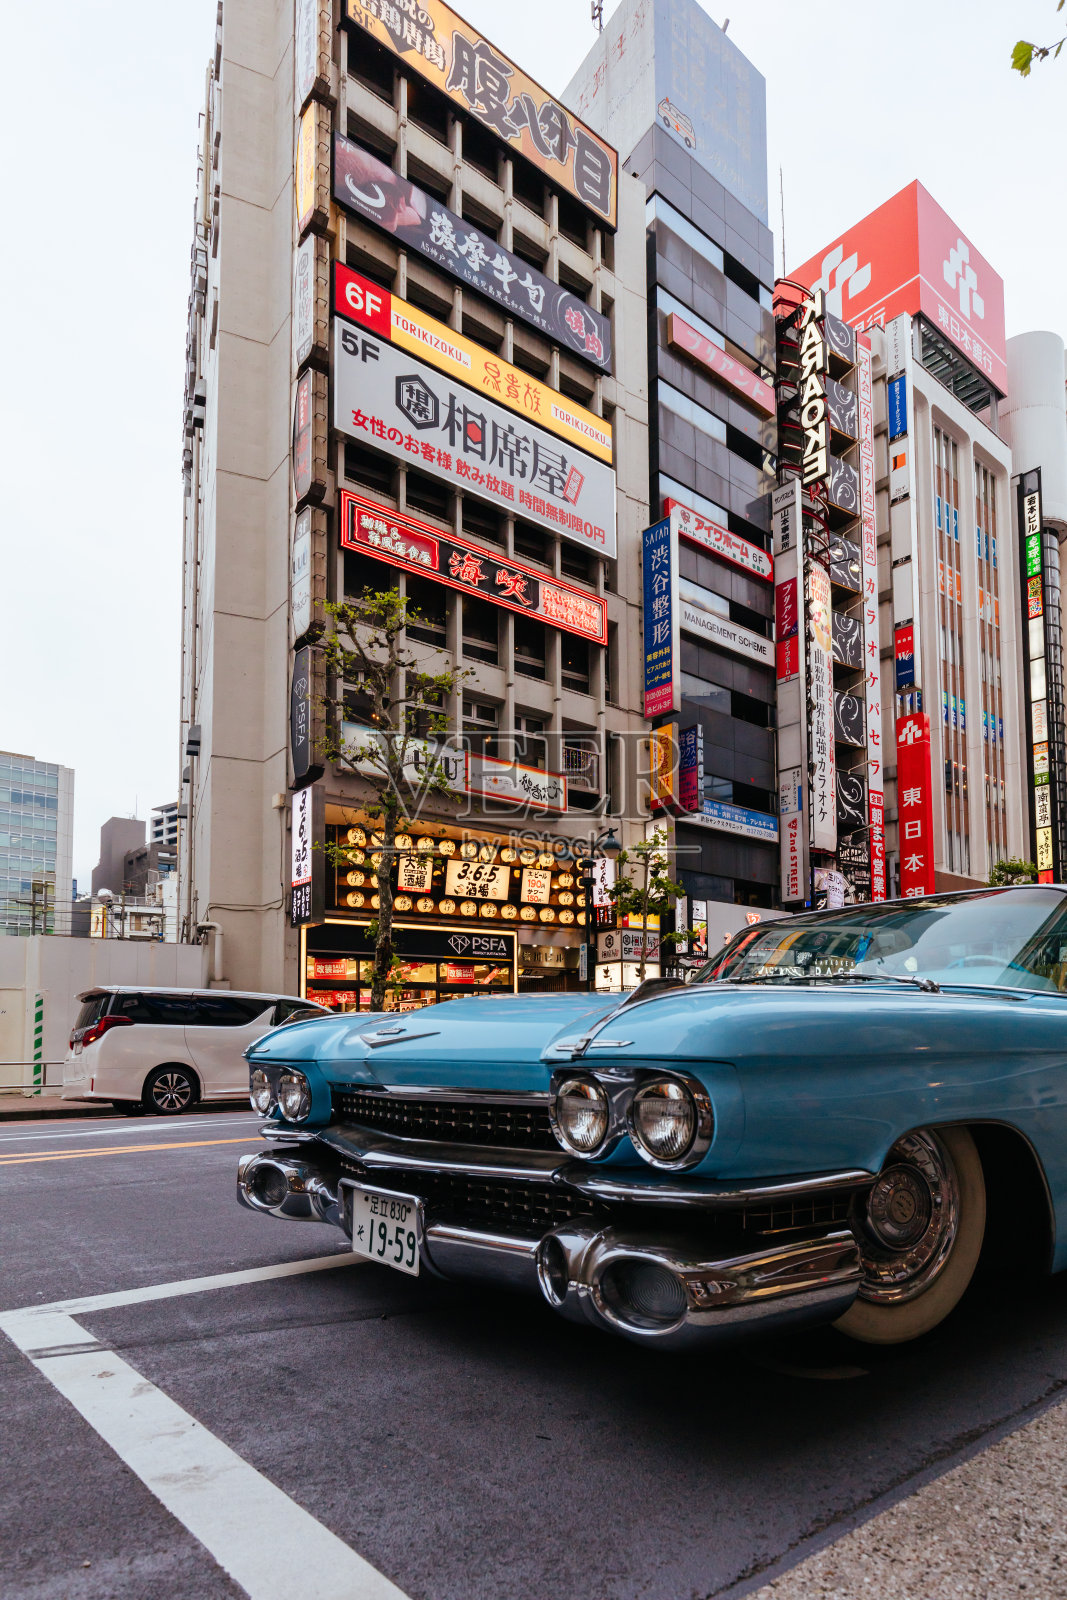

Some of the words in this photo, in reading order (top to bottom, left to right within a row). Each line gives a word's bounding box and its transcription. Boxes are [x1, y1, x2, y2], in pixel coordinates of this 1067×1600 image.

[353, 4, 376, 29] 8F
[447, 30, 611, 217] 腹八分目
[345, 282, 382, 317] 6F
[341, 327, 380, 364] 5F
[394, 313, 462, 362] TORIKIZOKU
[565, 306, 603, 360] 焼肉
[937, 304, 993, 374] 東日本銀行
[860, 352, 871, 398] ママ会
[441, 391, 570, 503] 相席屋
[553, 406, 606, 446] TORIKIZOKU
[861, 407, 872, 453] 女子会
[351, 408, 453, 472] 女性のお客様
[455, 458, 515, 502] 飲み放題
[518, 489, 606, 545] 時間無制限0円
[862, 462, 873, 508] オフ会
[695, 517, 749, 558] アイワホーム
[752, 553, 763, 564] 6F
[781, 509, 790, 550] 山本事務所
[651, 545, 670, 647] 渋谷整形
[647, 646, 670, 662] 美容外科
[684, 611, 737, 643] MANAGEMENT
[738, 635, 767, 656] SCHEME
[866, 578, 880, 776] カラオケパセラ
[298, 702, 306, 747] PSFA
[1036, 776, 1048, 785] 3F
[789, 832, 797, 853] 2nd
[404, 874, 426, 888] 酒場
[466, 882, 489, 897] 酒場
[790, 855, 799, 896] STREET
[472, 937, 507, 951] PSFA
[624, 947, 633, 955] 5F
[317, 964, 333, 974] 改装
[449, 968, 462, 978] 改装
[369, 1219, 416, 1268] 19-59
